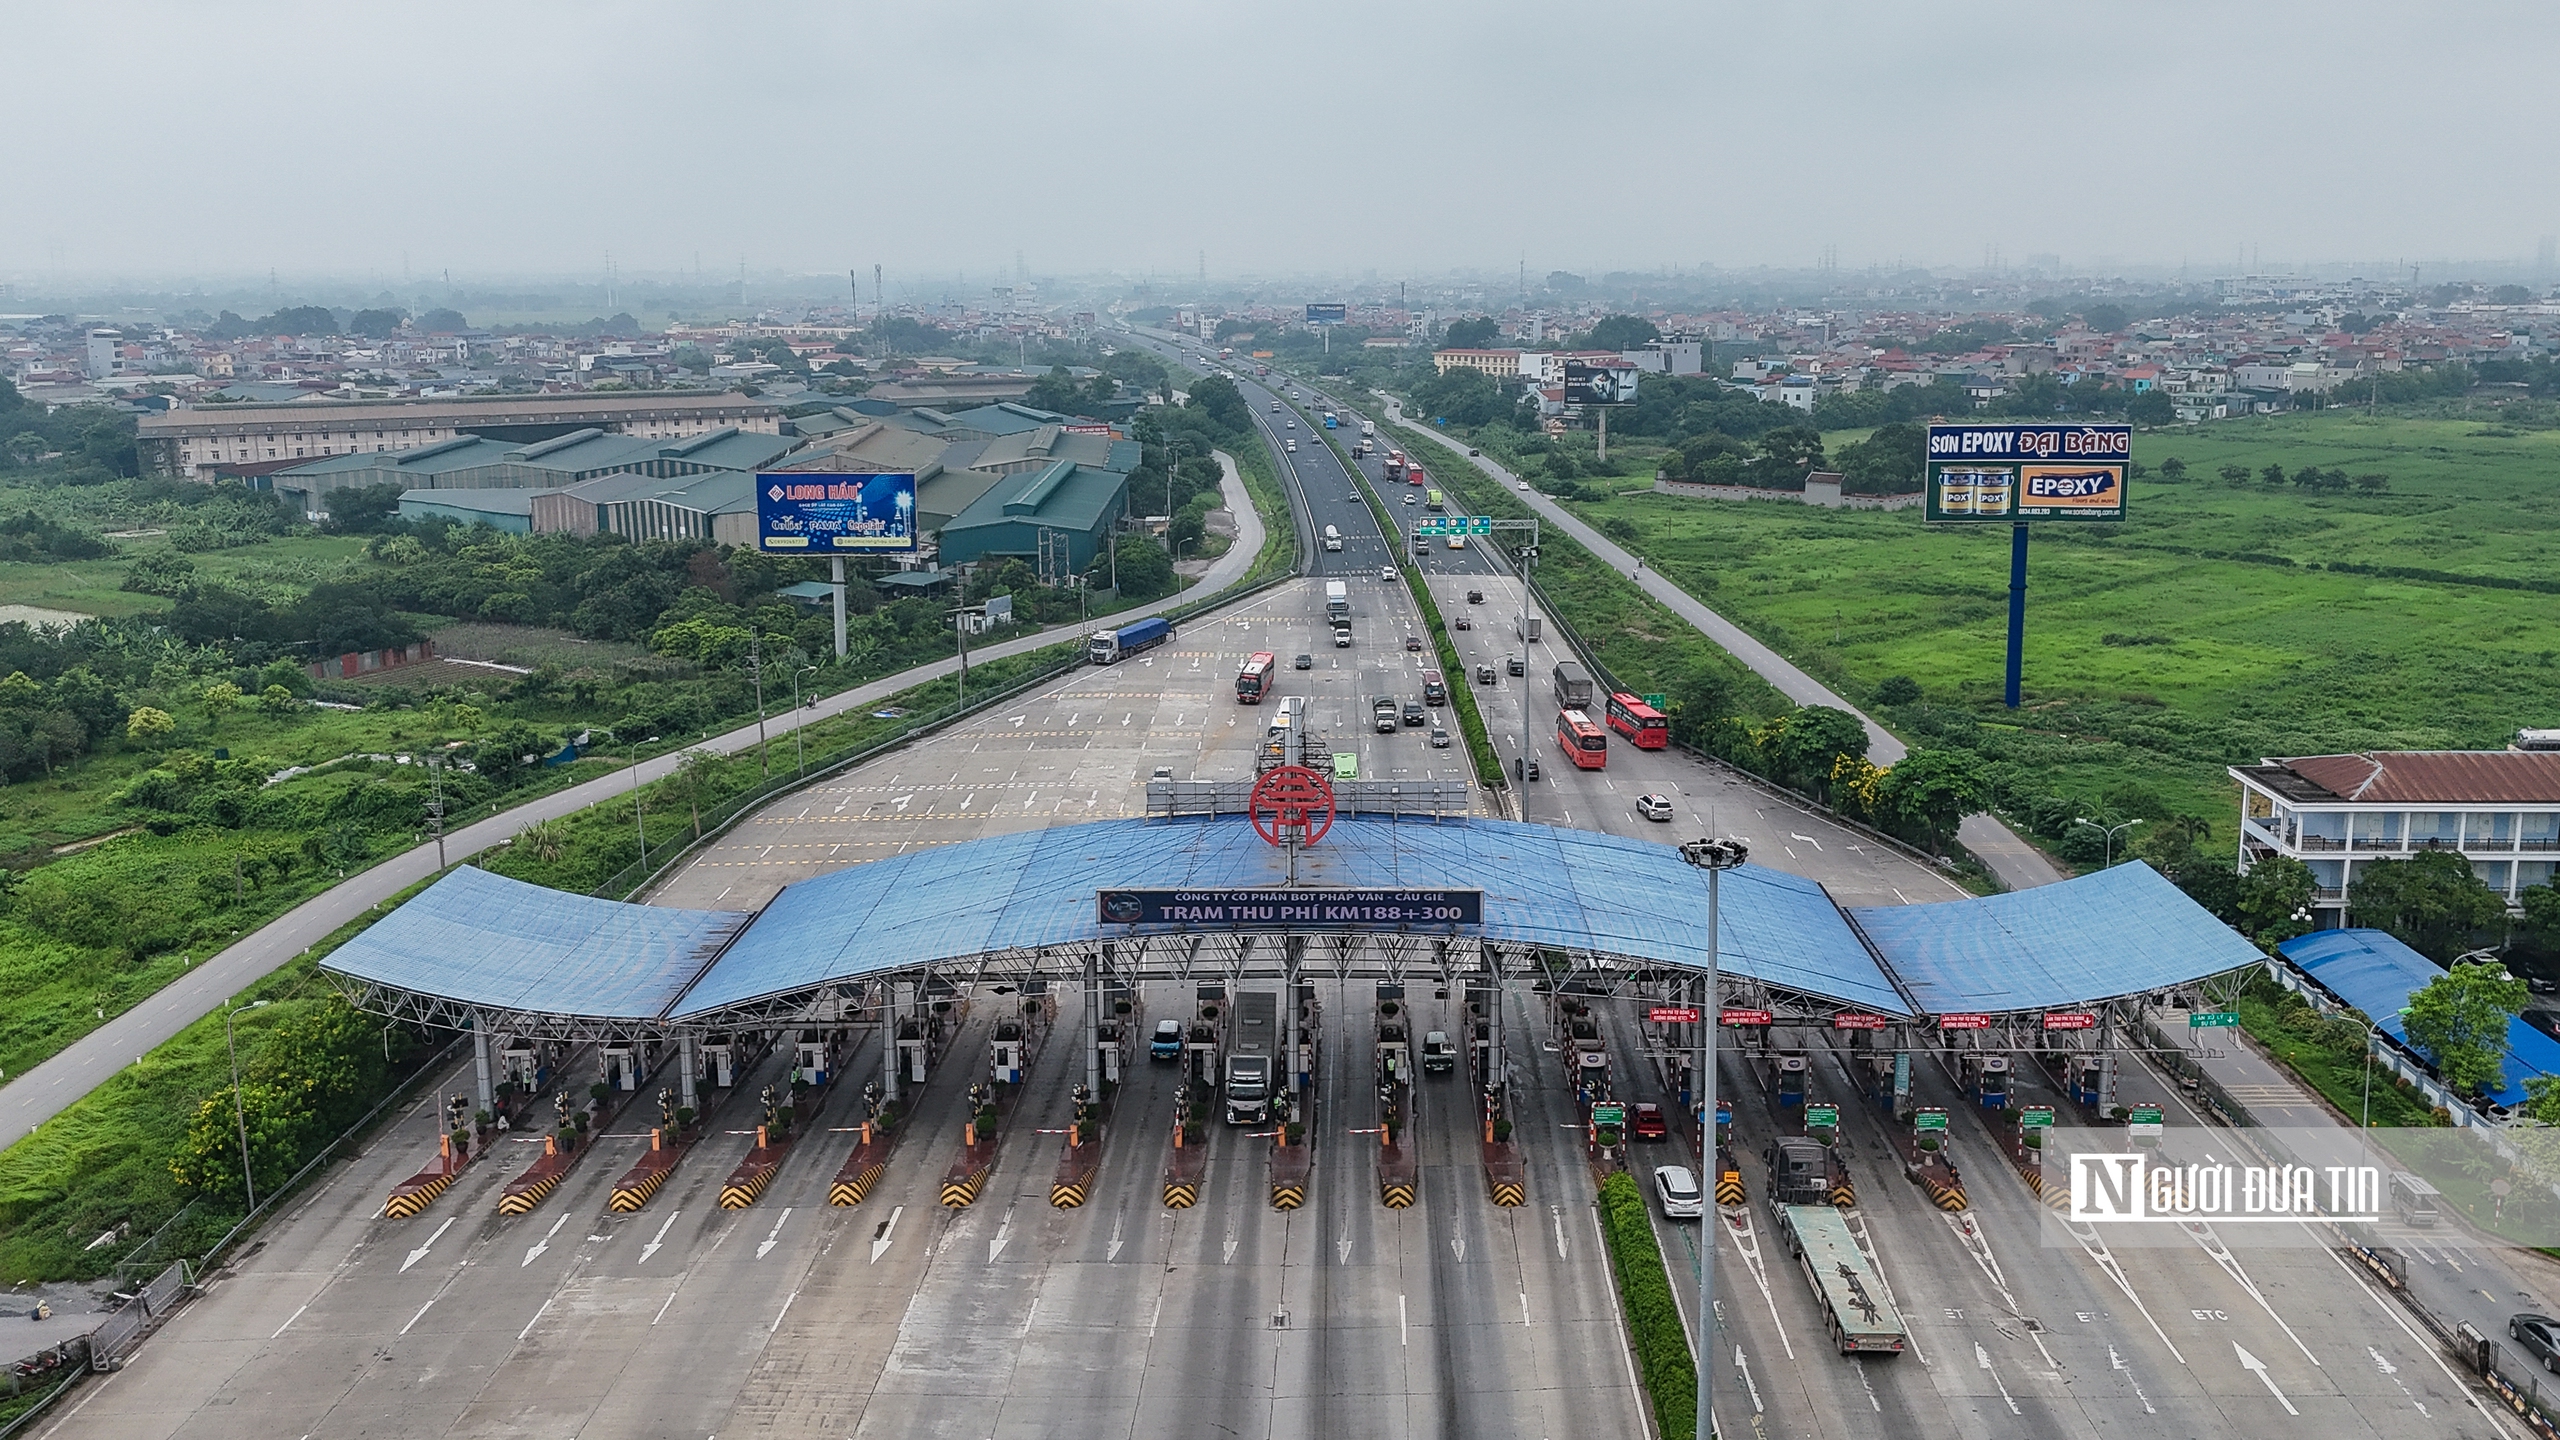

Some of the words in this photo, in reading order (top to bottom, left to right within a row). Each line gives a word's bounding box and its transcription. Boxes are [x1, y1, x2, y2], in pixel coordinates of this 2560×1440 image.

[1931, 434, 1959, 454] SƠN
[1962, 431, 2015, 453] EPOXY
[2018, 431, 2060, 457] ĐẠI
[2065, 428, 2129, 456] BÀNG
[786, 484, 825, 500] LONG
[828, 481, 858, 500] HẦU
[2031, 476, 2104, 496] EPOXY
[809, 520, 841, 531] PAVIA
[1174, 892, 1210, 902] CÔNG
[1213, 893, 1229, 901] TY
[1291, 893, 1317, 901] BOT
[1319, 891, 1355, 901] PHÁP
[1357, 892, 1384, 901] VÂN
[1107, 900, 1139, 912] MPC
[1160, 906, 1223, 923] TRẠM
[1229, 906, 1274, 919] THU
[1281, 903, 1320, 919] PHÍ
[1325, 906, 1463, 920] KM188+300
[2191, 1309, 2229, 1322] ETC
